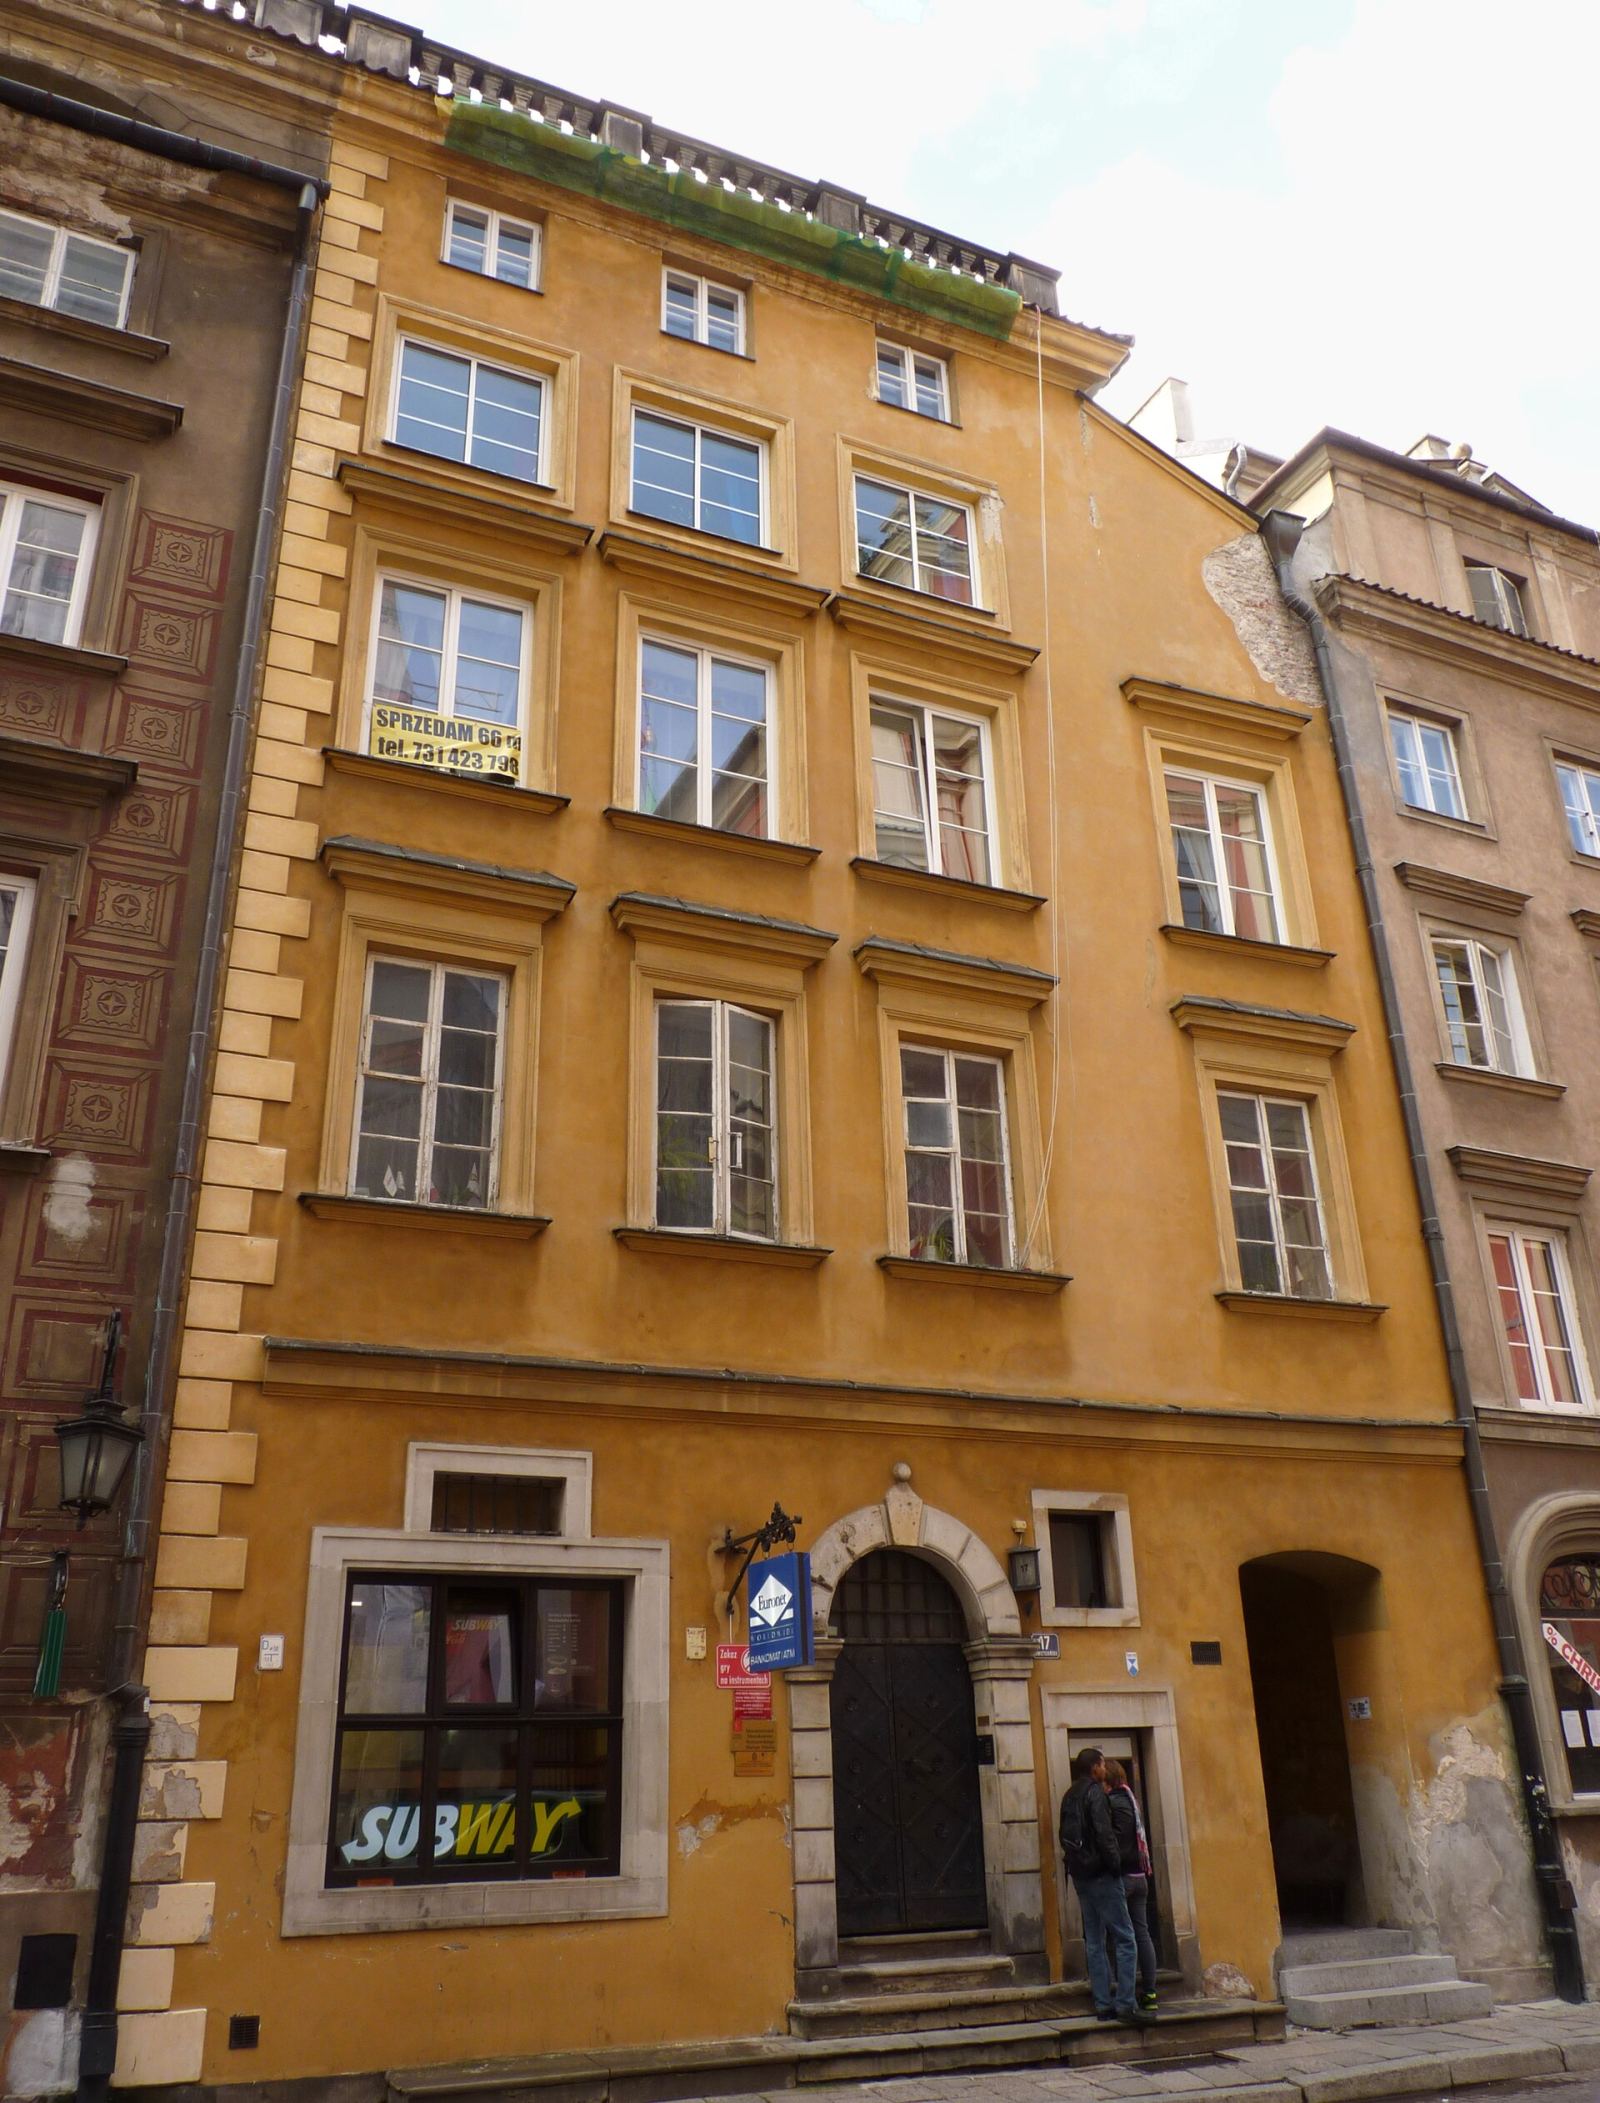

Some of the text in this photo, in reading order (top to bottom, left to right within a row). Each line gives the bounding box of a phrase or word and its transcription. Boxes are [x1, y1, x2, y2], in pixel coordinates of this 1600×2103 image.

[376, 709, 473, 742] SPRZEDAM
[478, 727, 502, 748] 66
[378, 736, 520, 776] tel. 731 423 798
[758, 1593, 787, 1611] Euronet
[451, 1618, 504, 1632] SUBWAY
[1038, 1635, 1050, 1650] 17
[719, 1649, 737, 1659] Zakaz
[720, 1665, 731, 1674] gry
[720, 1675, 769, 1685] na instrumentach
[341, 1797, 582, 1863] SUBWAY
